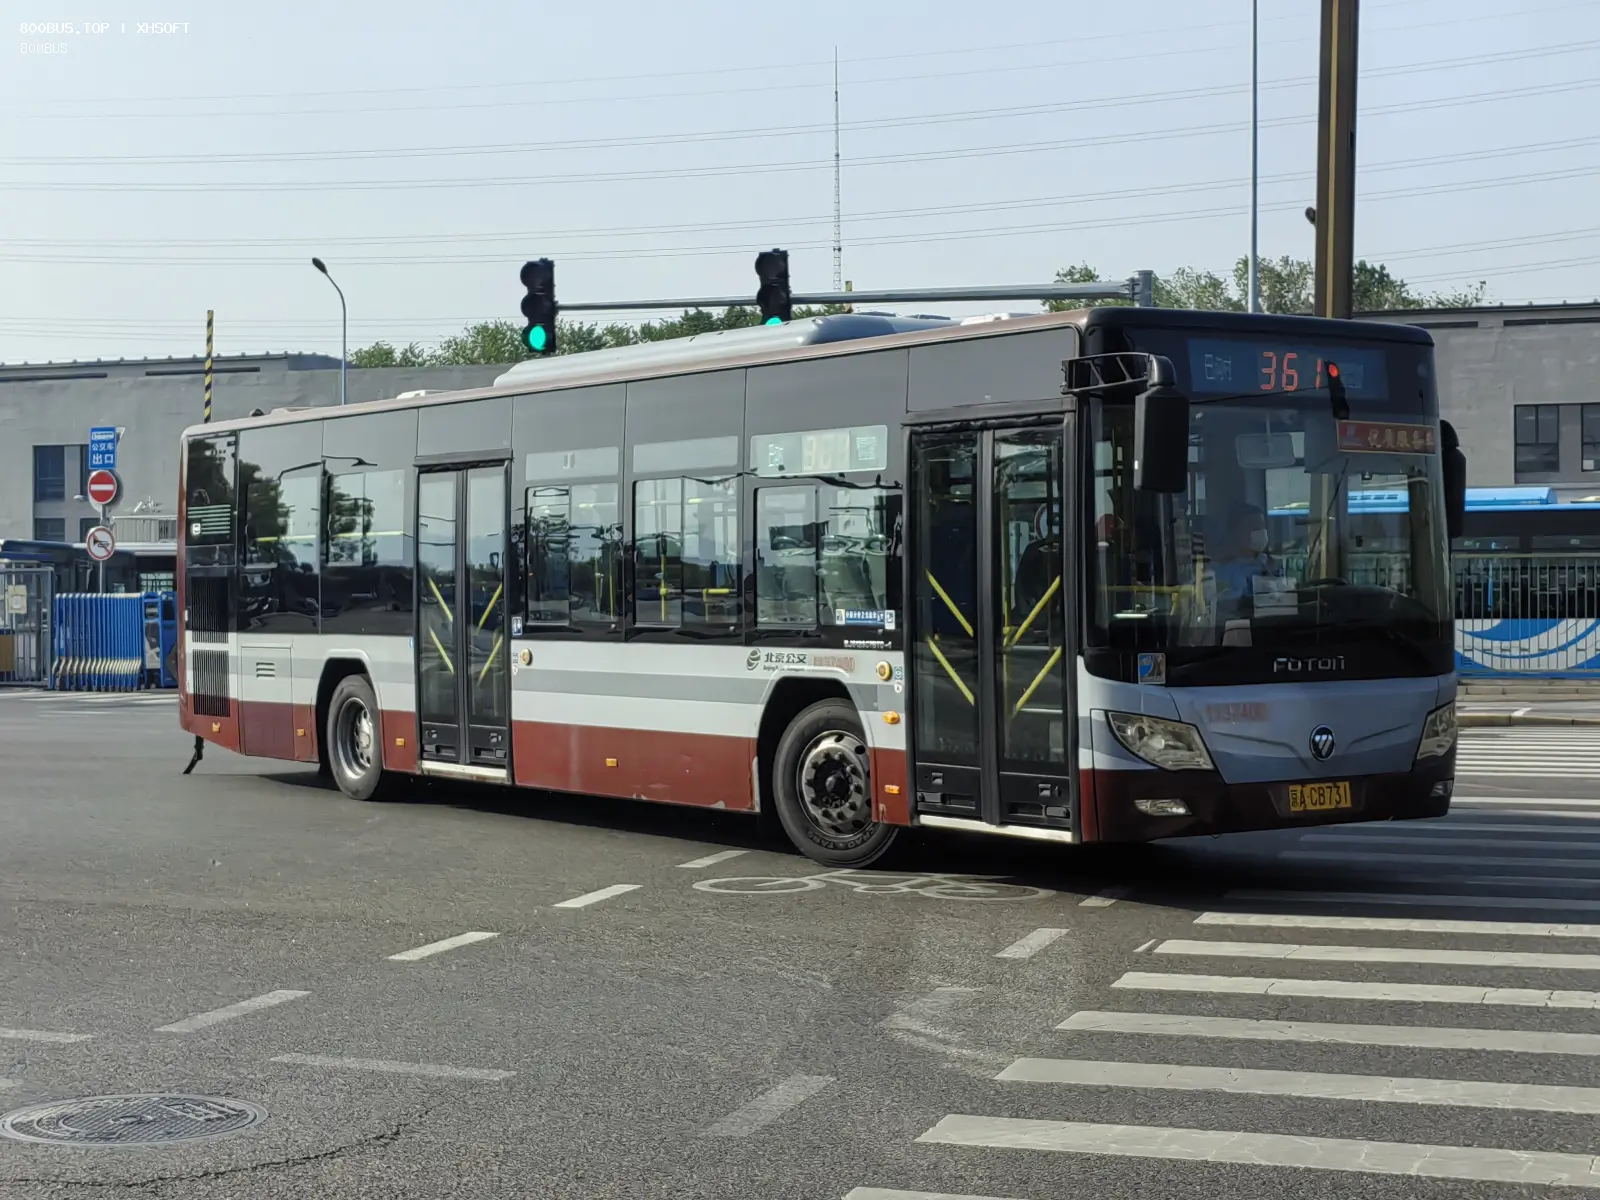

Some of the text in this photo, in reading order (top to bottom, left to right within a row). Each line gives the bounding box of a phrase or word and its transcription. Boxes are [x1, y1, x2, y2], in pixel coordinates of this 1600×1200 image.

[1260, 351, 1322, 391] 361
[92, 442, 114, 451] 公交车
[92, 453, 114, 465] 出口
[765, 652, 807, 664] 北京公交
